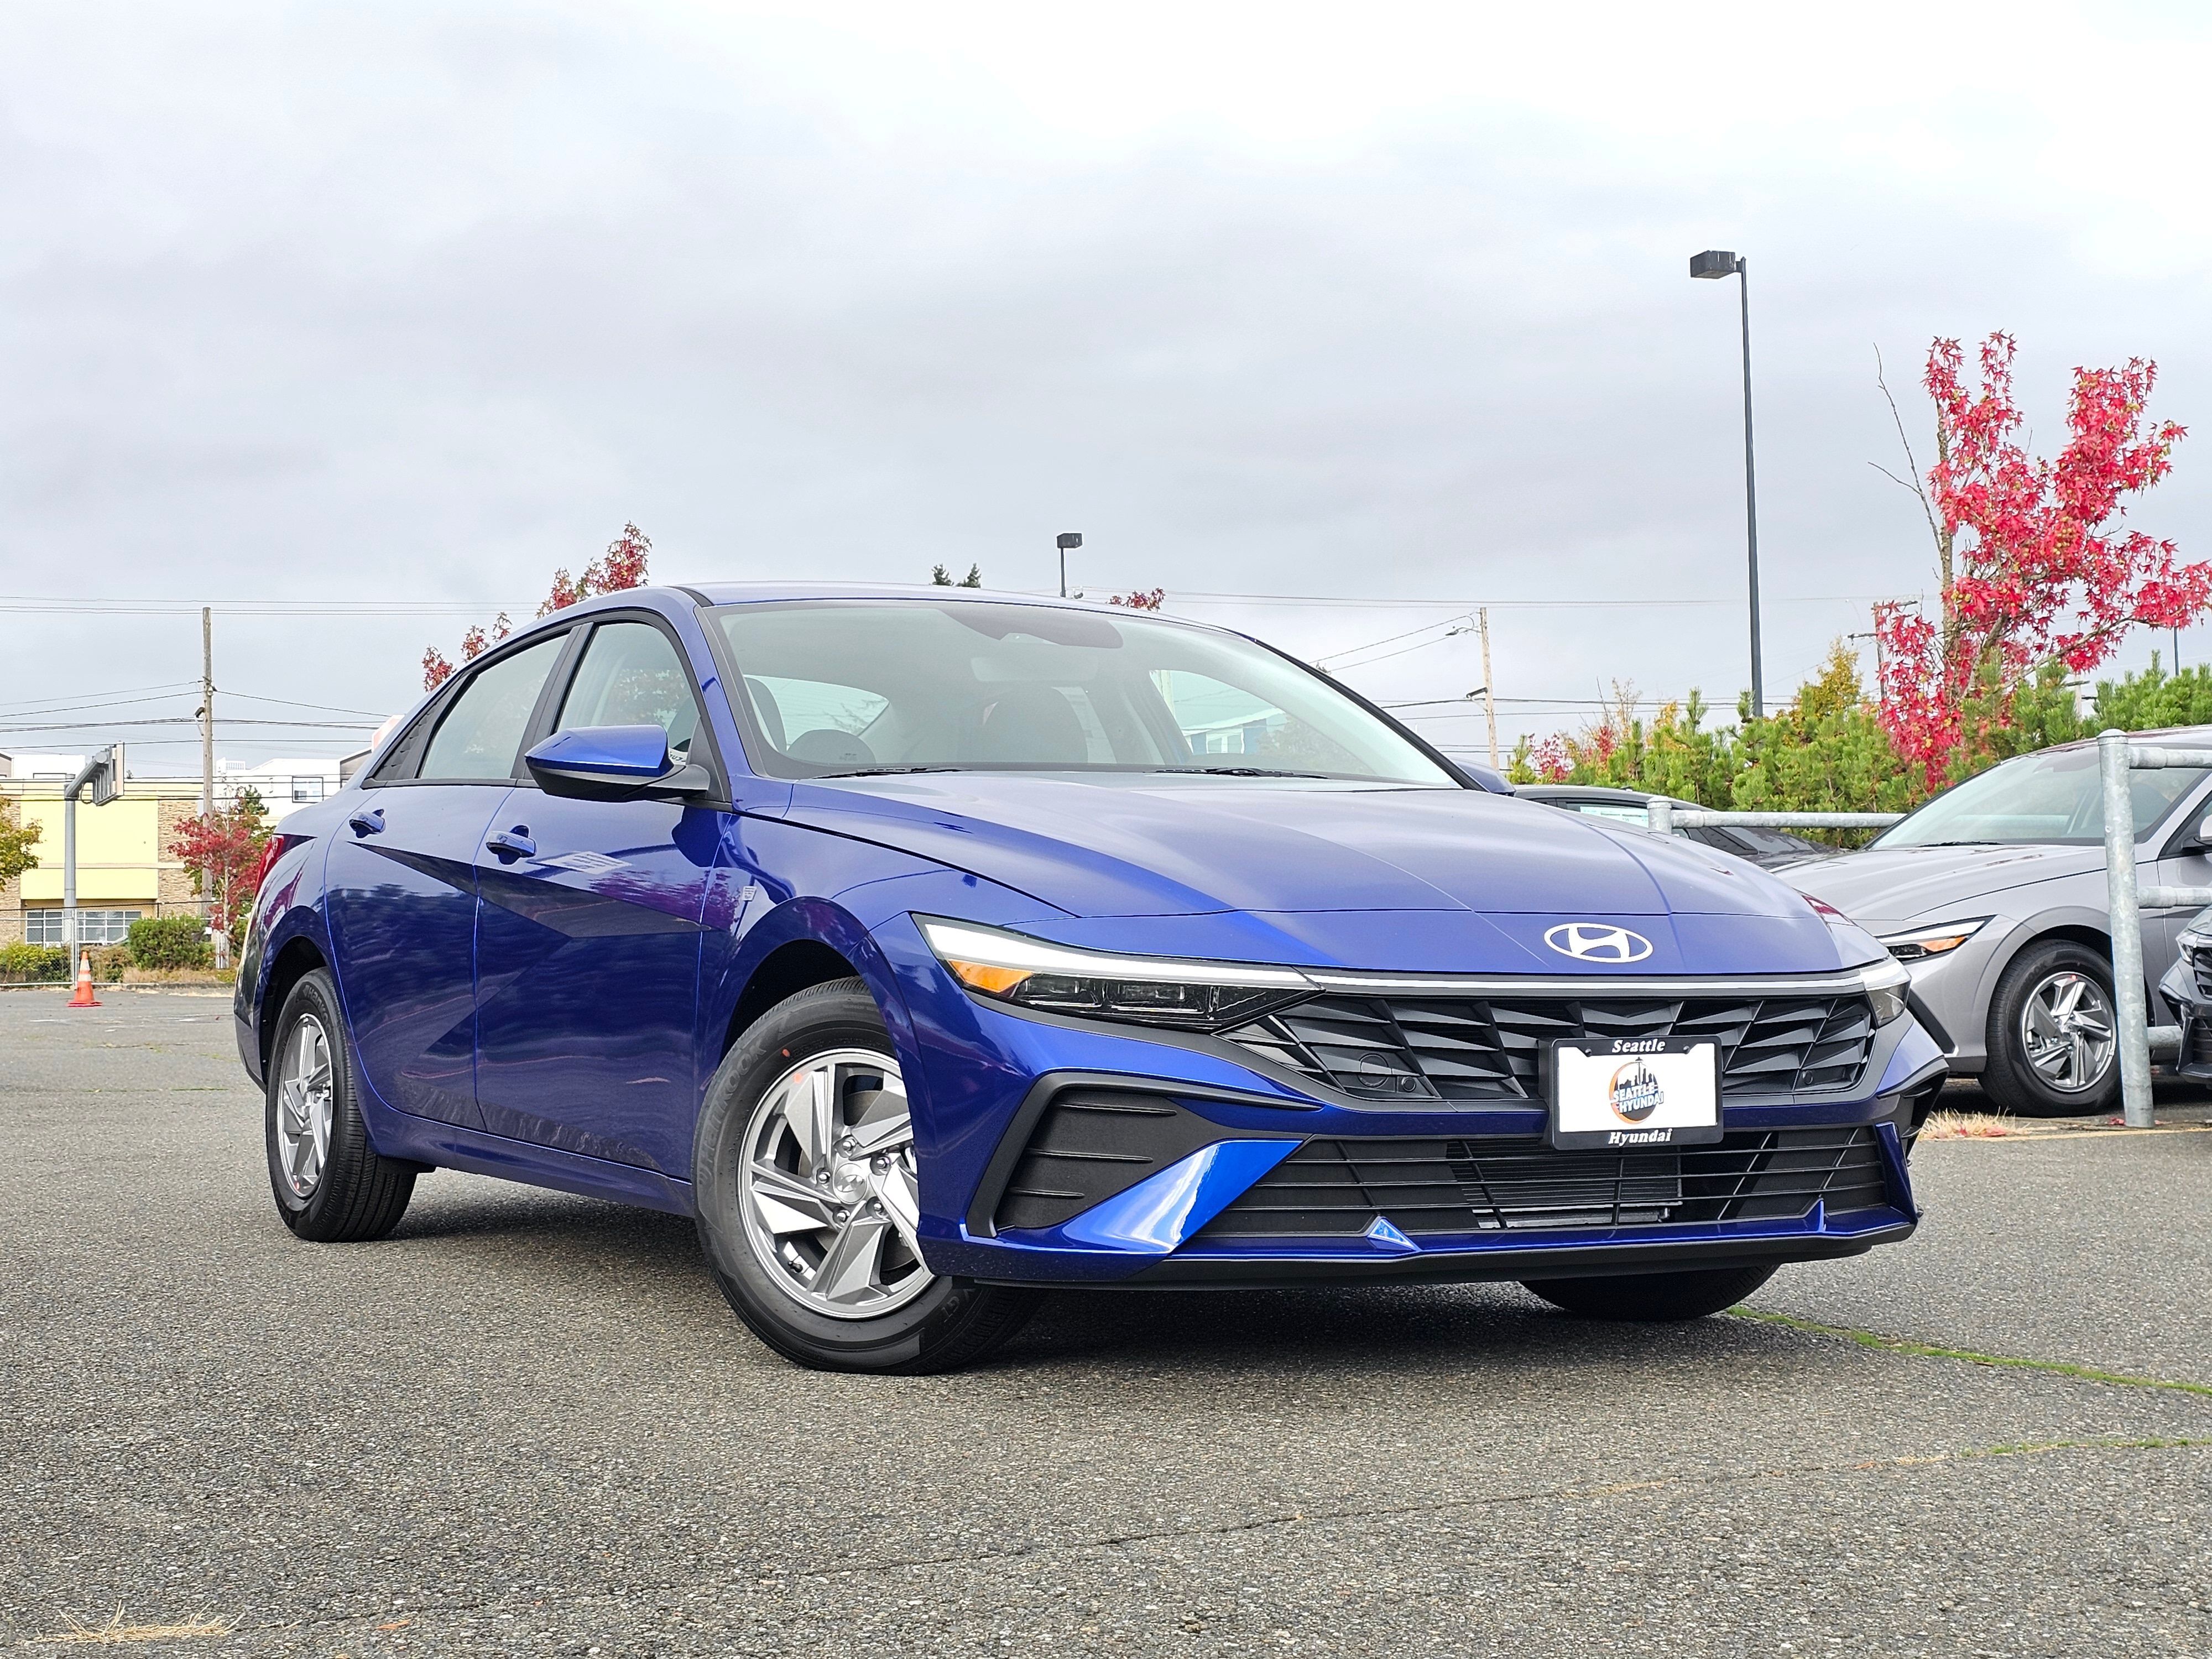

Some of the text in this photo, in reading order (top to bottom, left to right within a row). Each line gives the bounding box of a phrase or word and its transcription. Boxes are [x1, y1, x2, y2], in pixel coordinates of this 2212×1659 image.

[1612, 1039, 1666, 1053] Seattle
[1613, 1082, 1655, 1102] SEATTLE
[1619, 1091, 1664, 1113] HYUNDAI
[1608, 1129, 1673, 1146] Hyundai
